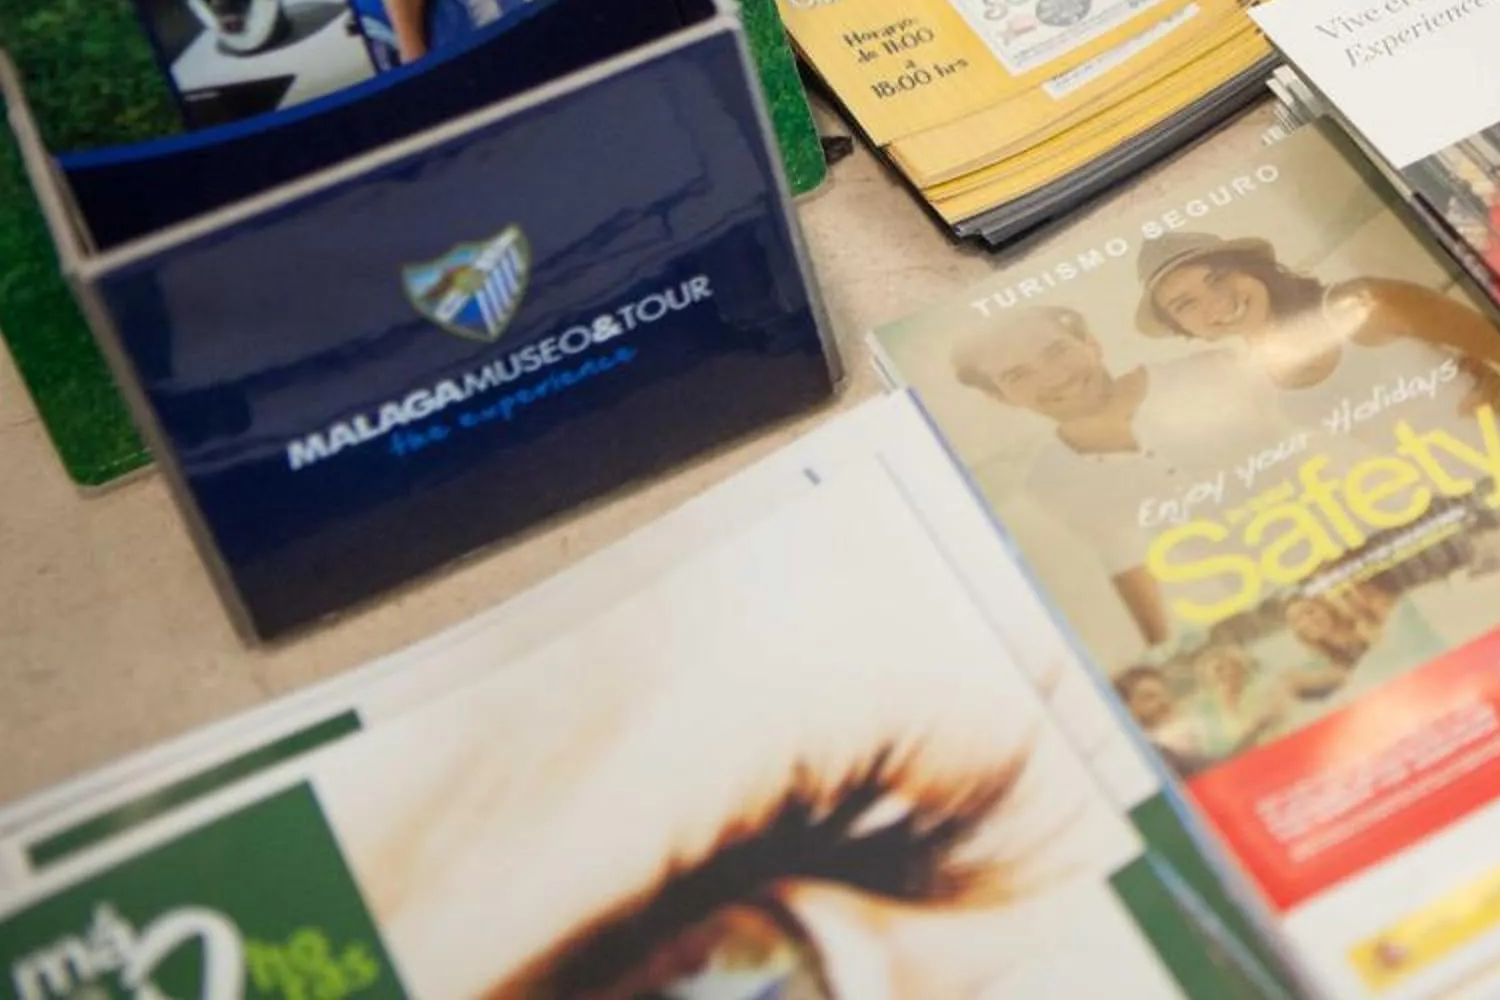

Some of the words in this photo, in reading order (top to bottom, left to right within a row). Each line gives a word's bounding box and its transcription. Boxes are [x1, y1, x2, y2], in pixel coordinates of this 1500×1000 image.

[870, 69, 932, 100] 18:00
[933, 57, 969, 78] hrs
[1313, 5, 1382, 41] Vive
[969, 236, 1131, 319] TURISMO
[1139, 163, 1281, 242] SEGURO
[388, 418, 452, 457] the
[458, 344, 639, 428] experience
[1136, 470, 1226, 530] Enjoy
[1234, 431, 1310, 487] your
[1322, 356, 1461, 434] Holidays
